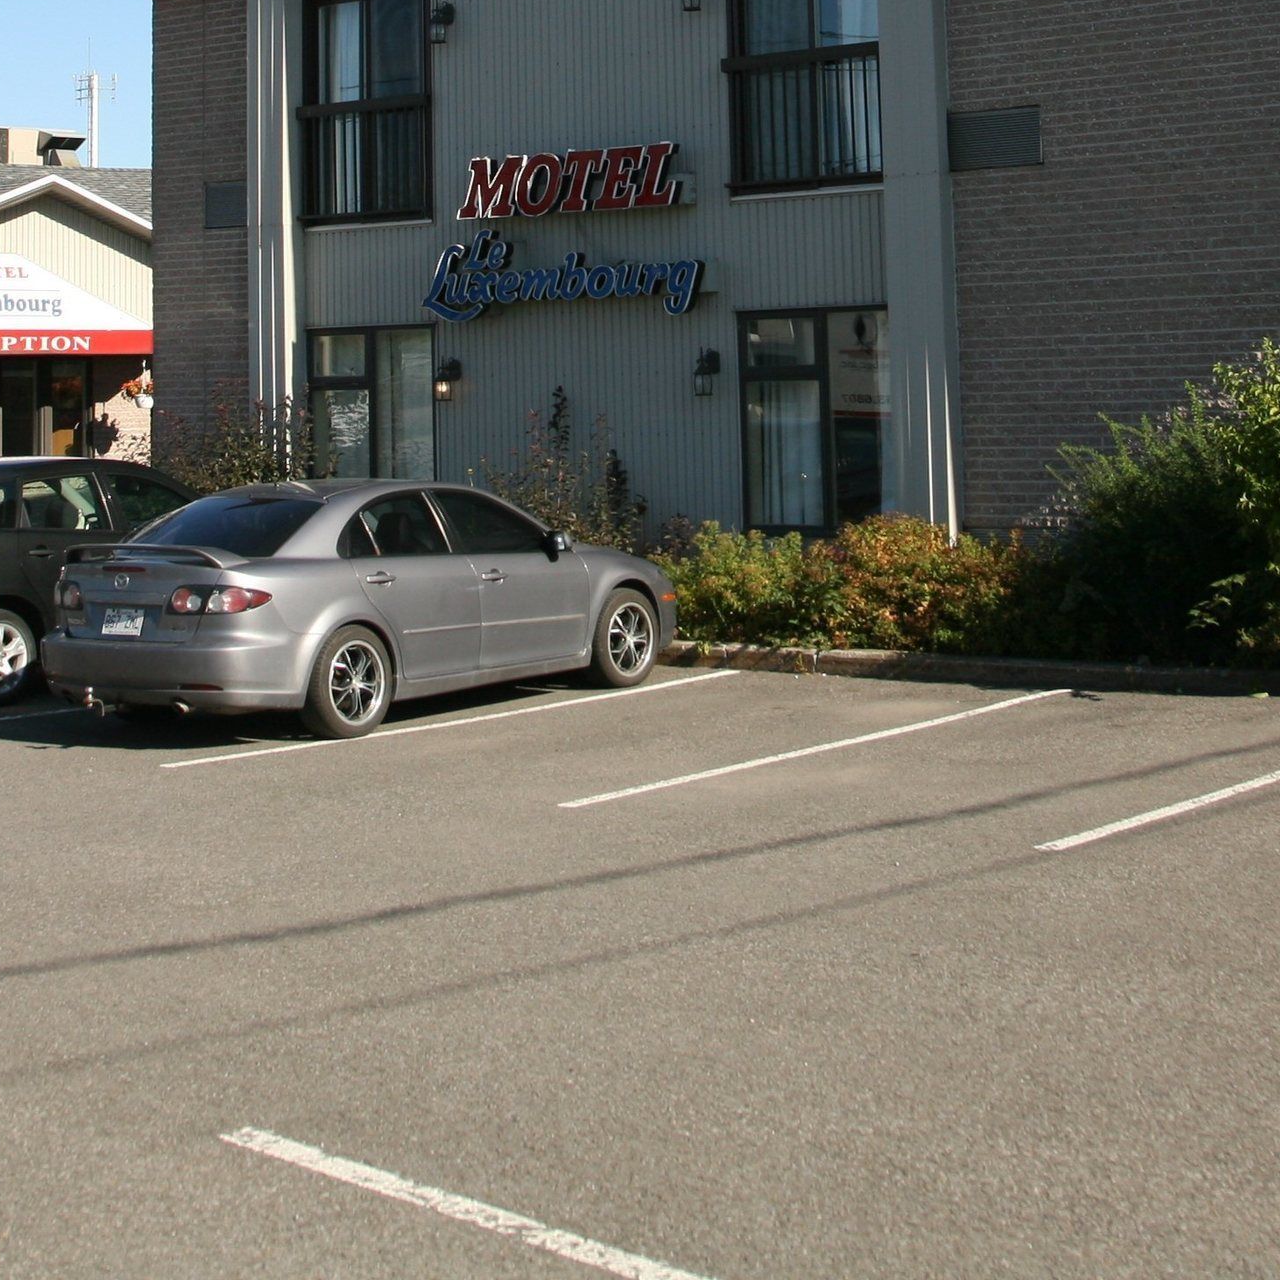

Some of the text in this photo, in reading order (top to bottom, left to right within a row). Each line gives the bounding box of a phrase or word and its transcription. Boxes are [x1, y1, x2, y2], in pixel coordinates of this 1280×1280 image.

[456, 140, 680, 221] MOTEL
[422, 242, 706, 322] Luxembourg
[463, 228, 512, 271] Le
